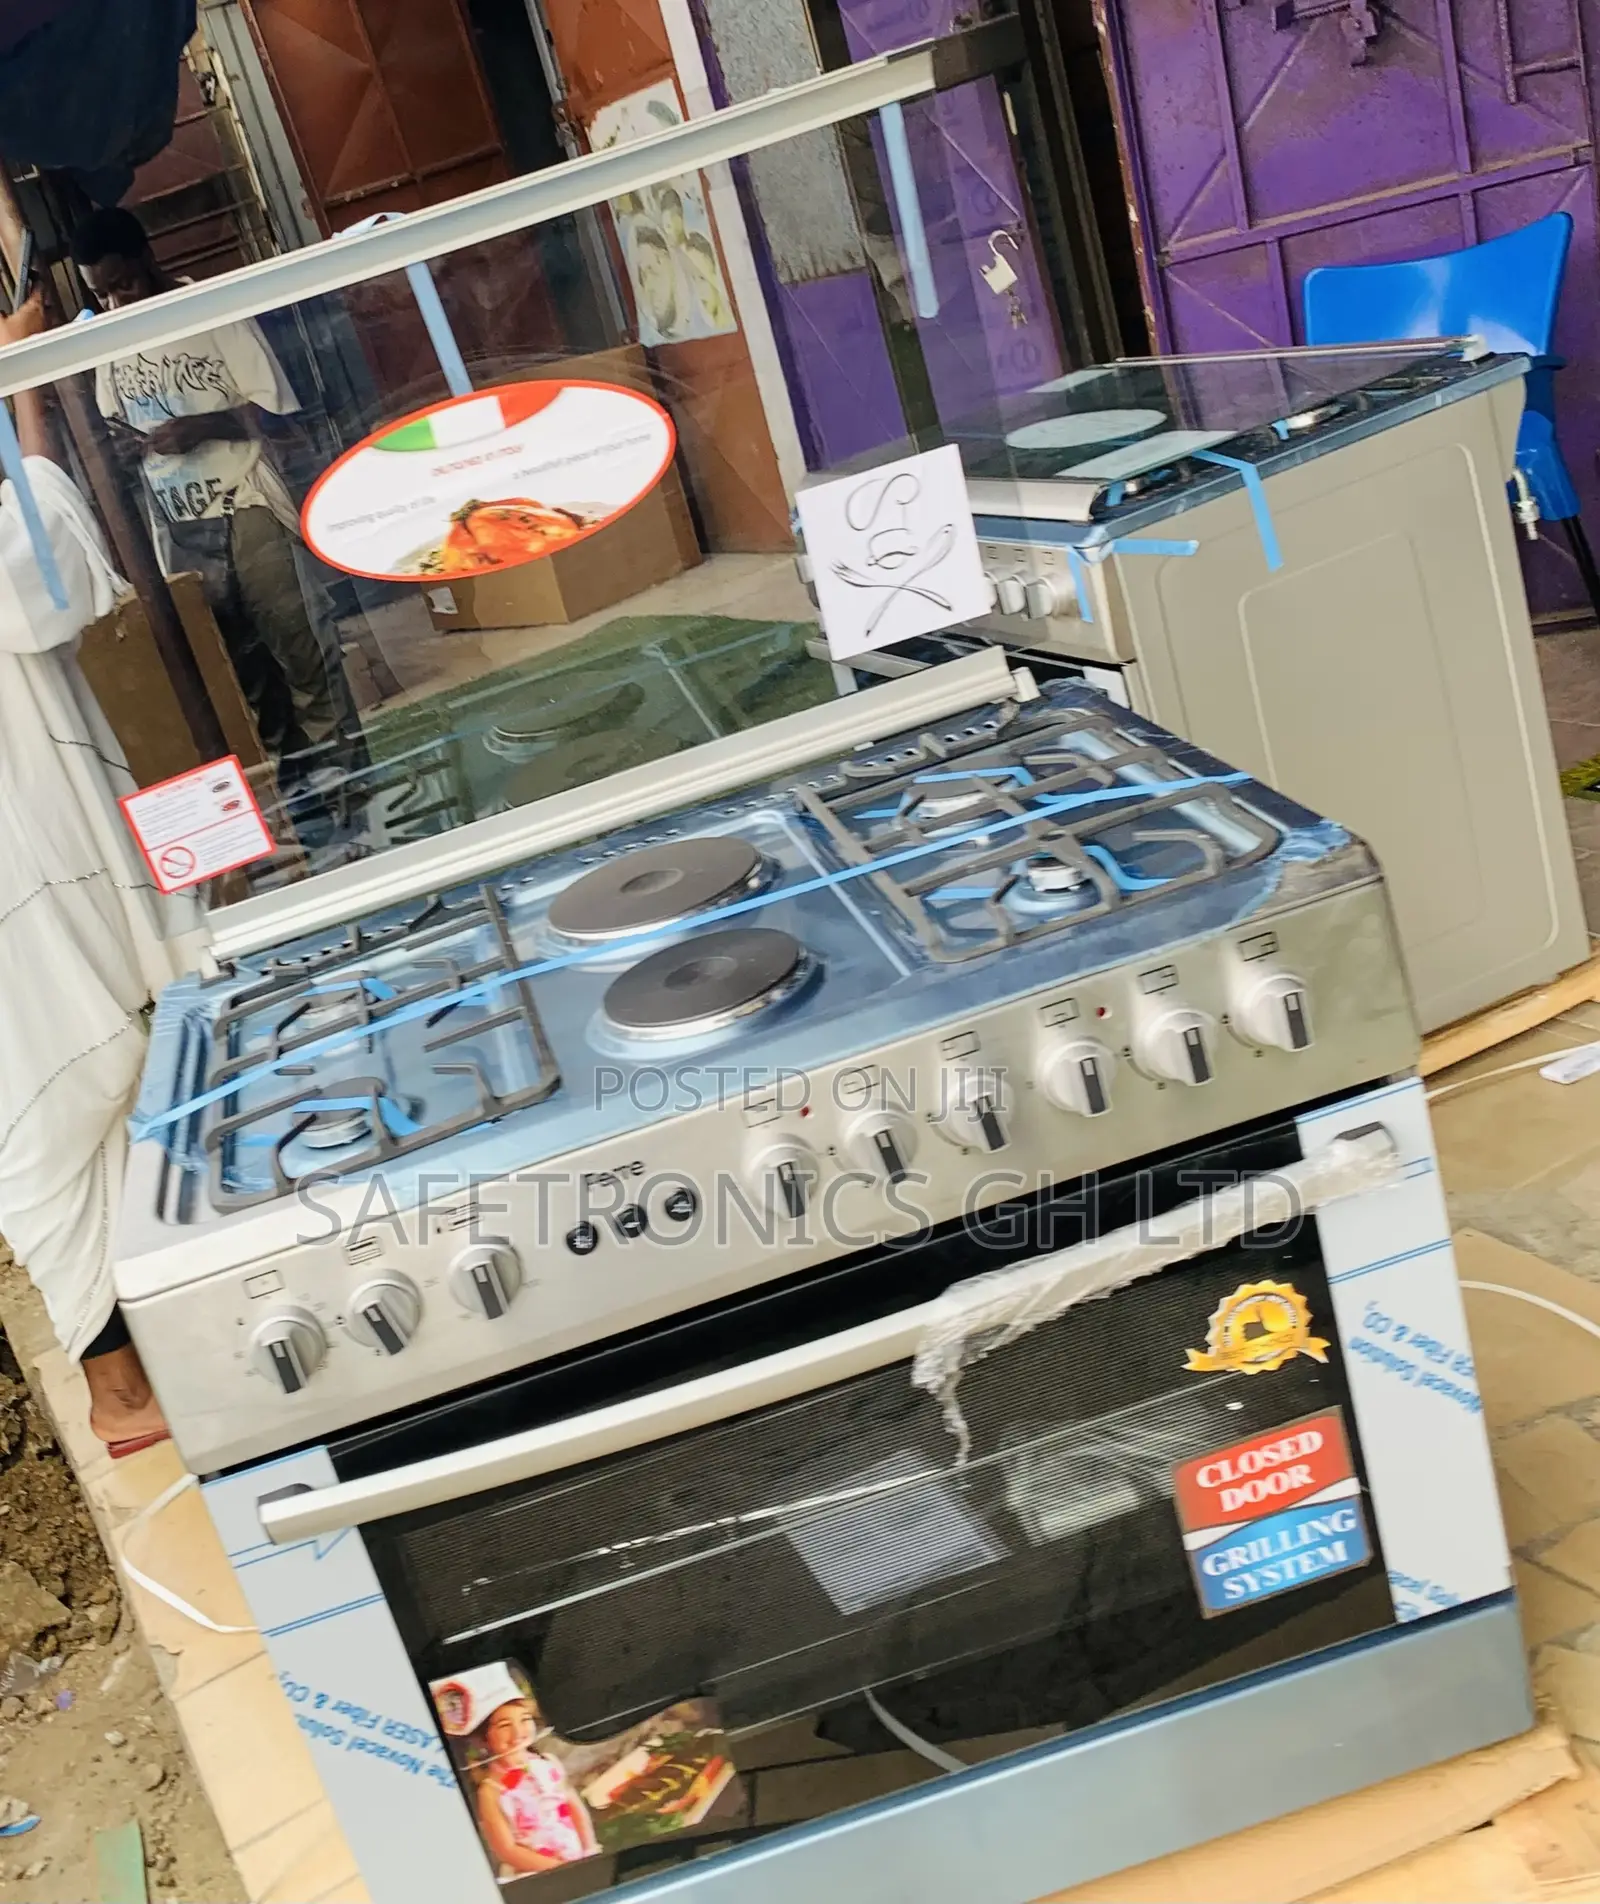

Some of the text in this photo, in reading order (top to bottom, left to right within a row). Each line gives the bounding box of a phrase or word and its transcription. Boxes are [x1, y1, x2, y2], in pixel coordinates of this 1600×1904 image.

[1196, 1430, 1324, 1488] CLOSED
[1217, 1464, 1316, 1513] DOOR
[1202, 1508, 1357, 1577] GRILLING
[1222, 1540, 1349, 1602] SYSTEM
[345, 1735, 424, 1775] Novacel
[382, 1718, 444, 1753] ASER
